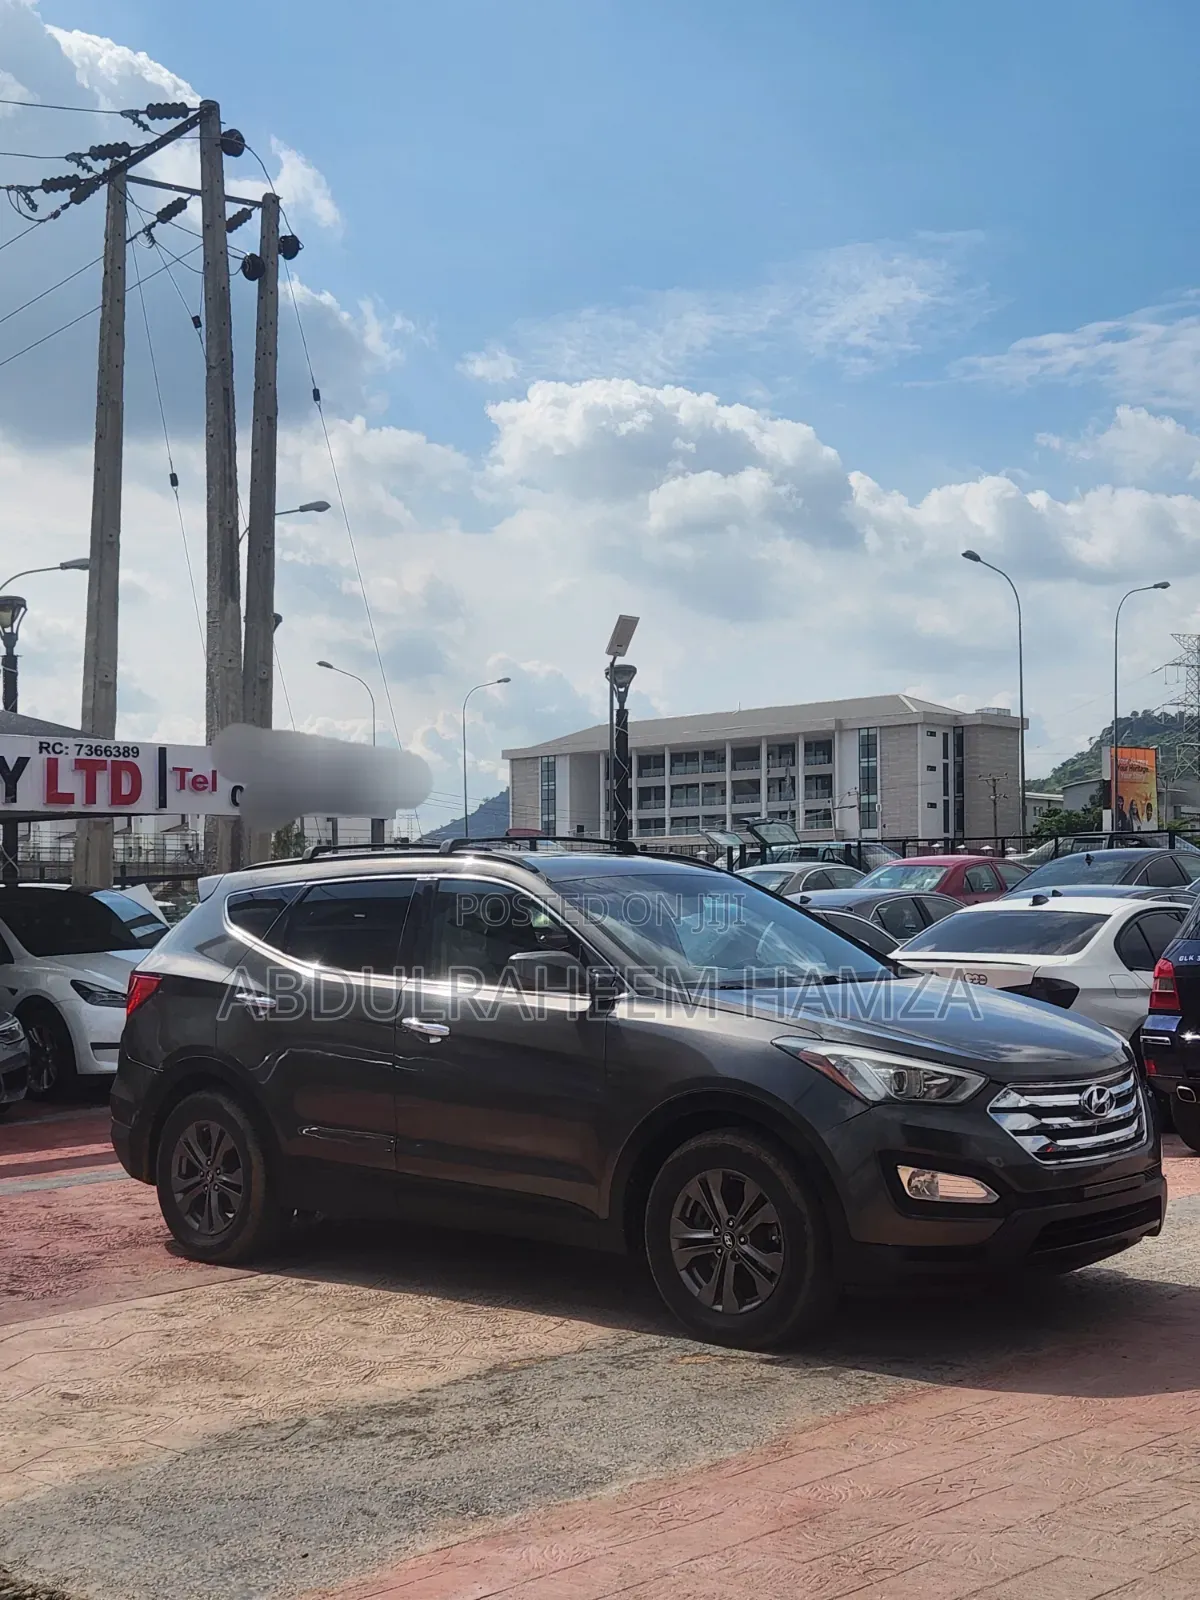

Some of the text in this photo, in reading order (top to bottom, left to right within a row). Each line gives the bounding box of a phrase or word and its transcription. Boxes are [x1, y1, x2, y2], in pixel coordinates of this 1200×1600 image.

[38, 741, 140, 758] RC: 7366389
[45, 757, 142, 805] LTD
[172, 767, 217, 792] Tel
